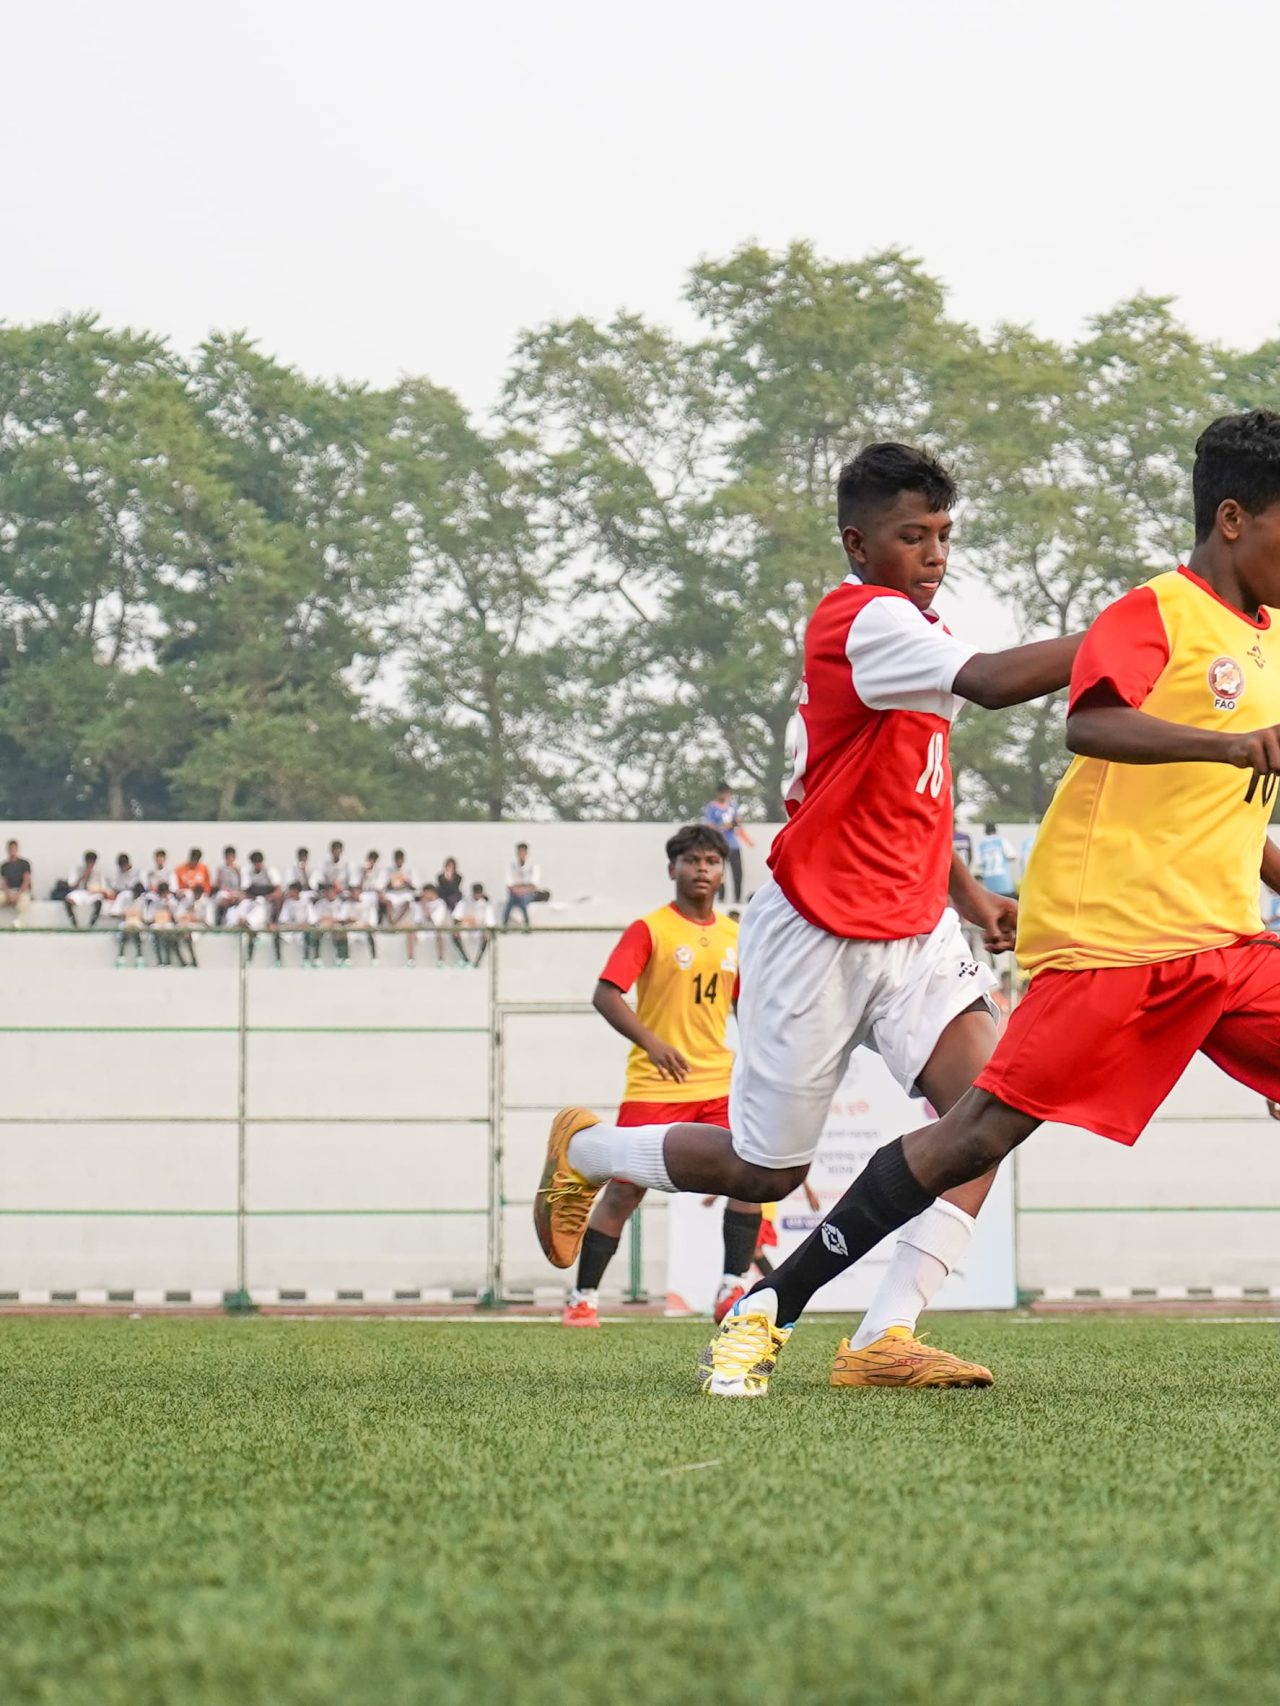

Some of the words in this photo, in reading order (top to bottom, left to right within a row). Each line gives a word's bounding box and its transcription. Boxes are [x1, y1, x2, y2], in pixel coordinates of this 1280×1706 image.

[1215, 699, 1235, 710] FAO
[915, 732, 944, 799] 18
[693, 972, 718, 1004] 14
